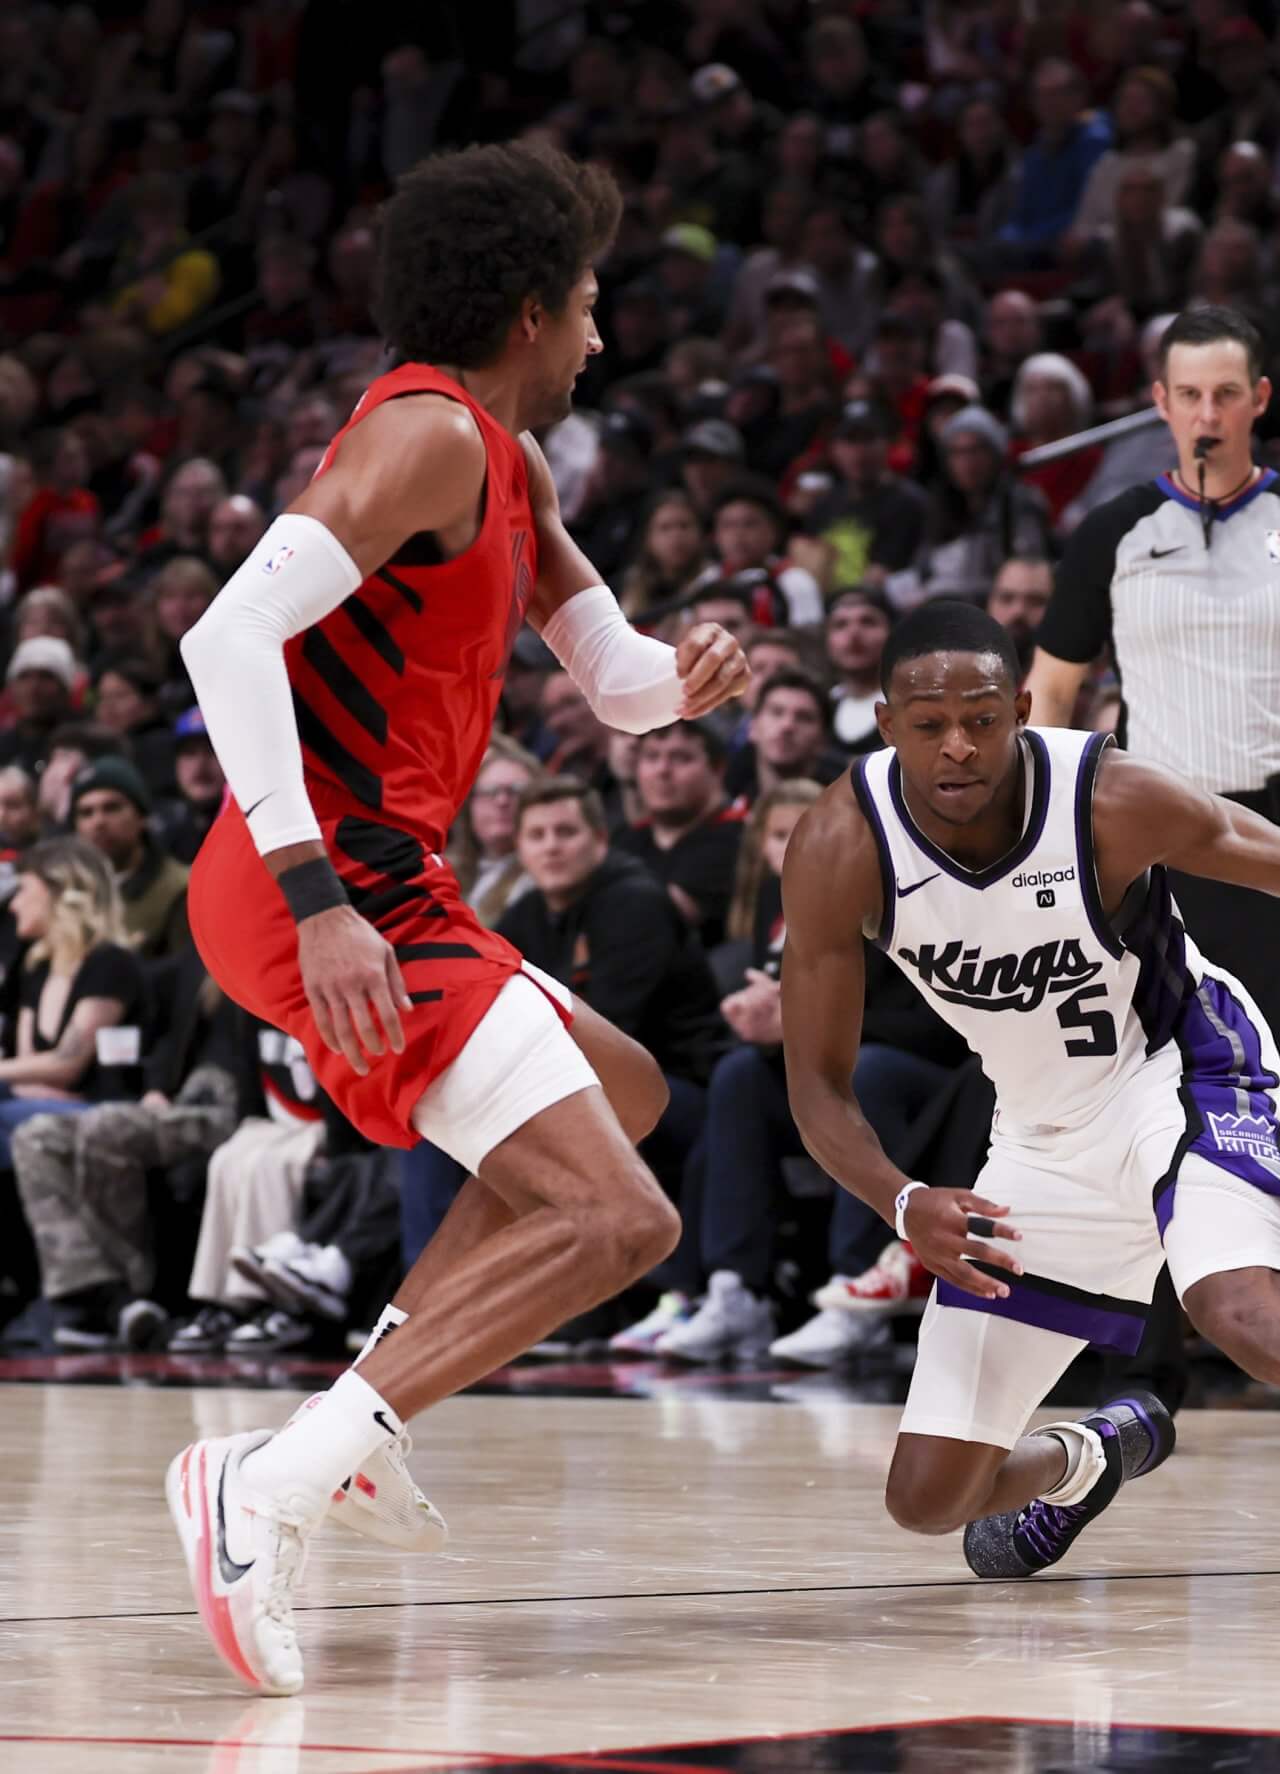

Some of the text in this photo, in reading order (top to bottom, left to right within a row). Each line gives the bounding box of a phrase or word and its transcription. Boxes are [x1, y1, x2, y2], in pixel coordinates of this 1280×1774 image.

[1012, 865, 1075, 888] dialpad
[897, 938, 1103, 1013] Kings
[1056, 983, 1118, 1057] 5
